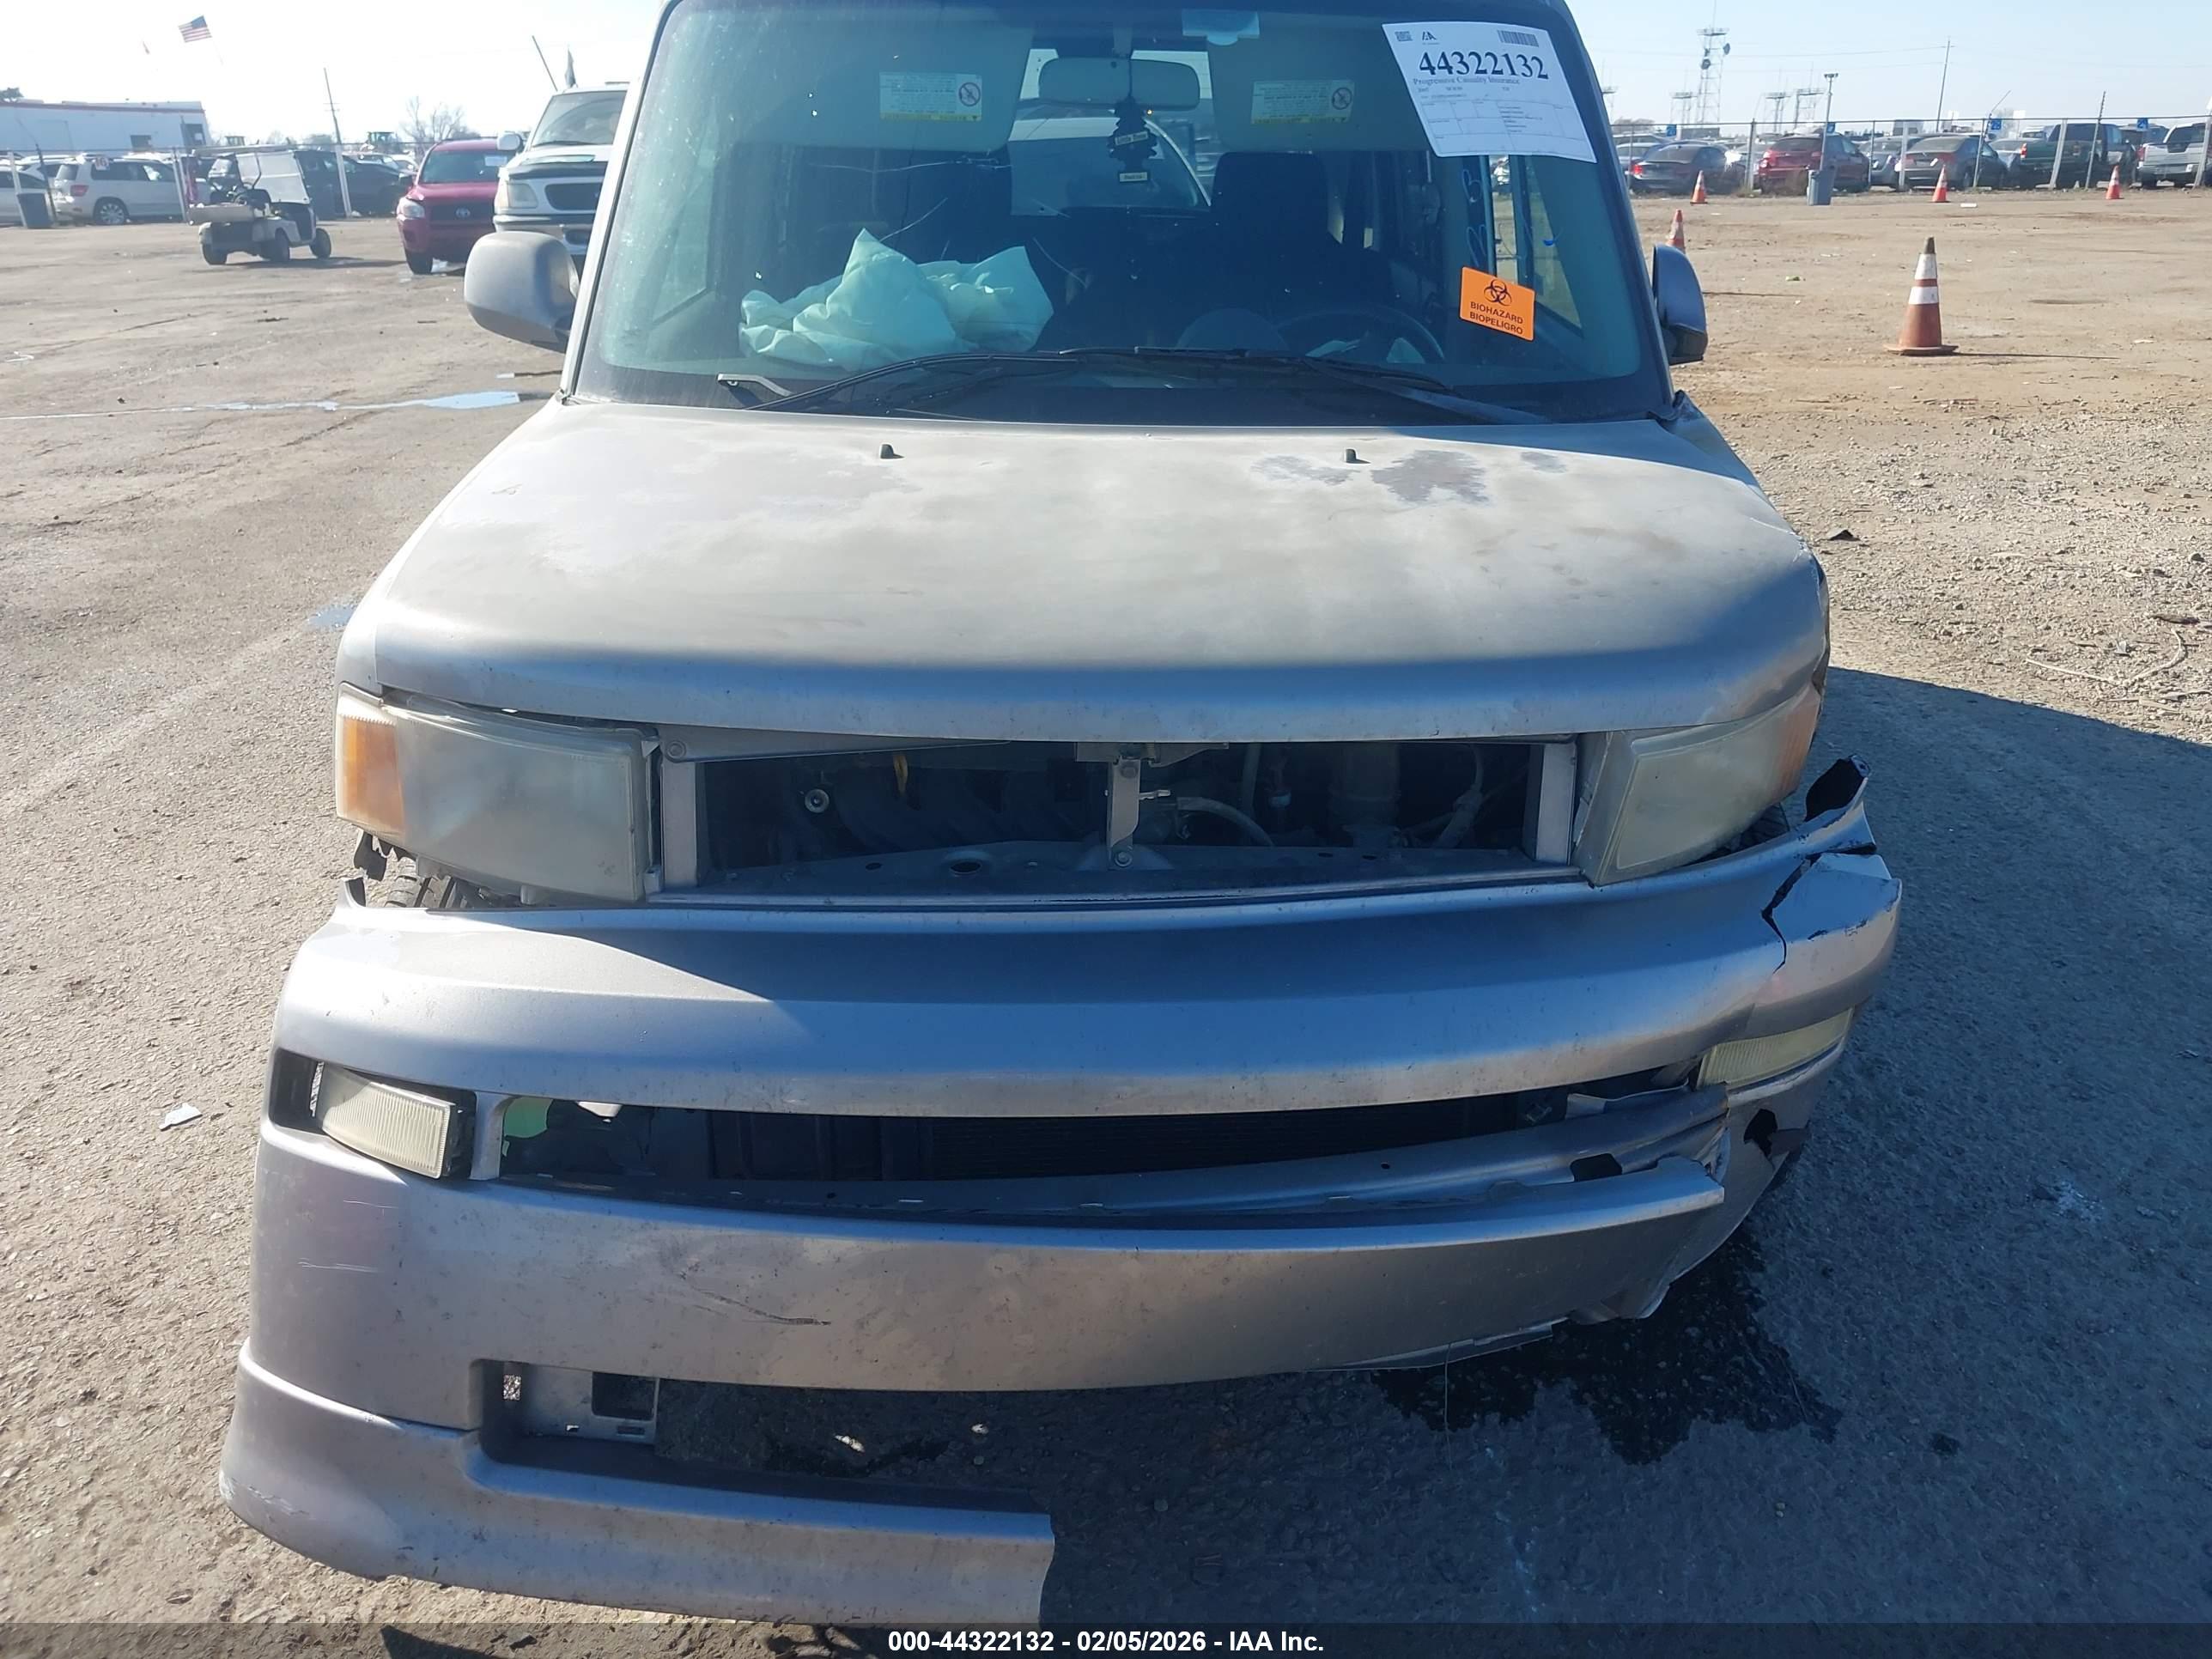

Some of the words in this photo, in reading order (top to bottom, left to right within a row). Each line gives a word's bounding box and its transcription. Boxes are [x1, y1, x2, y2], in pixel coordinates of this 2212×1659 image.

[1419, 52, 1549, 80] 44322132
[1469, 312, 1524, 335] BIOPELIGRO
[1470, 301, 1524, 325] BIOHAZARD
